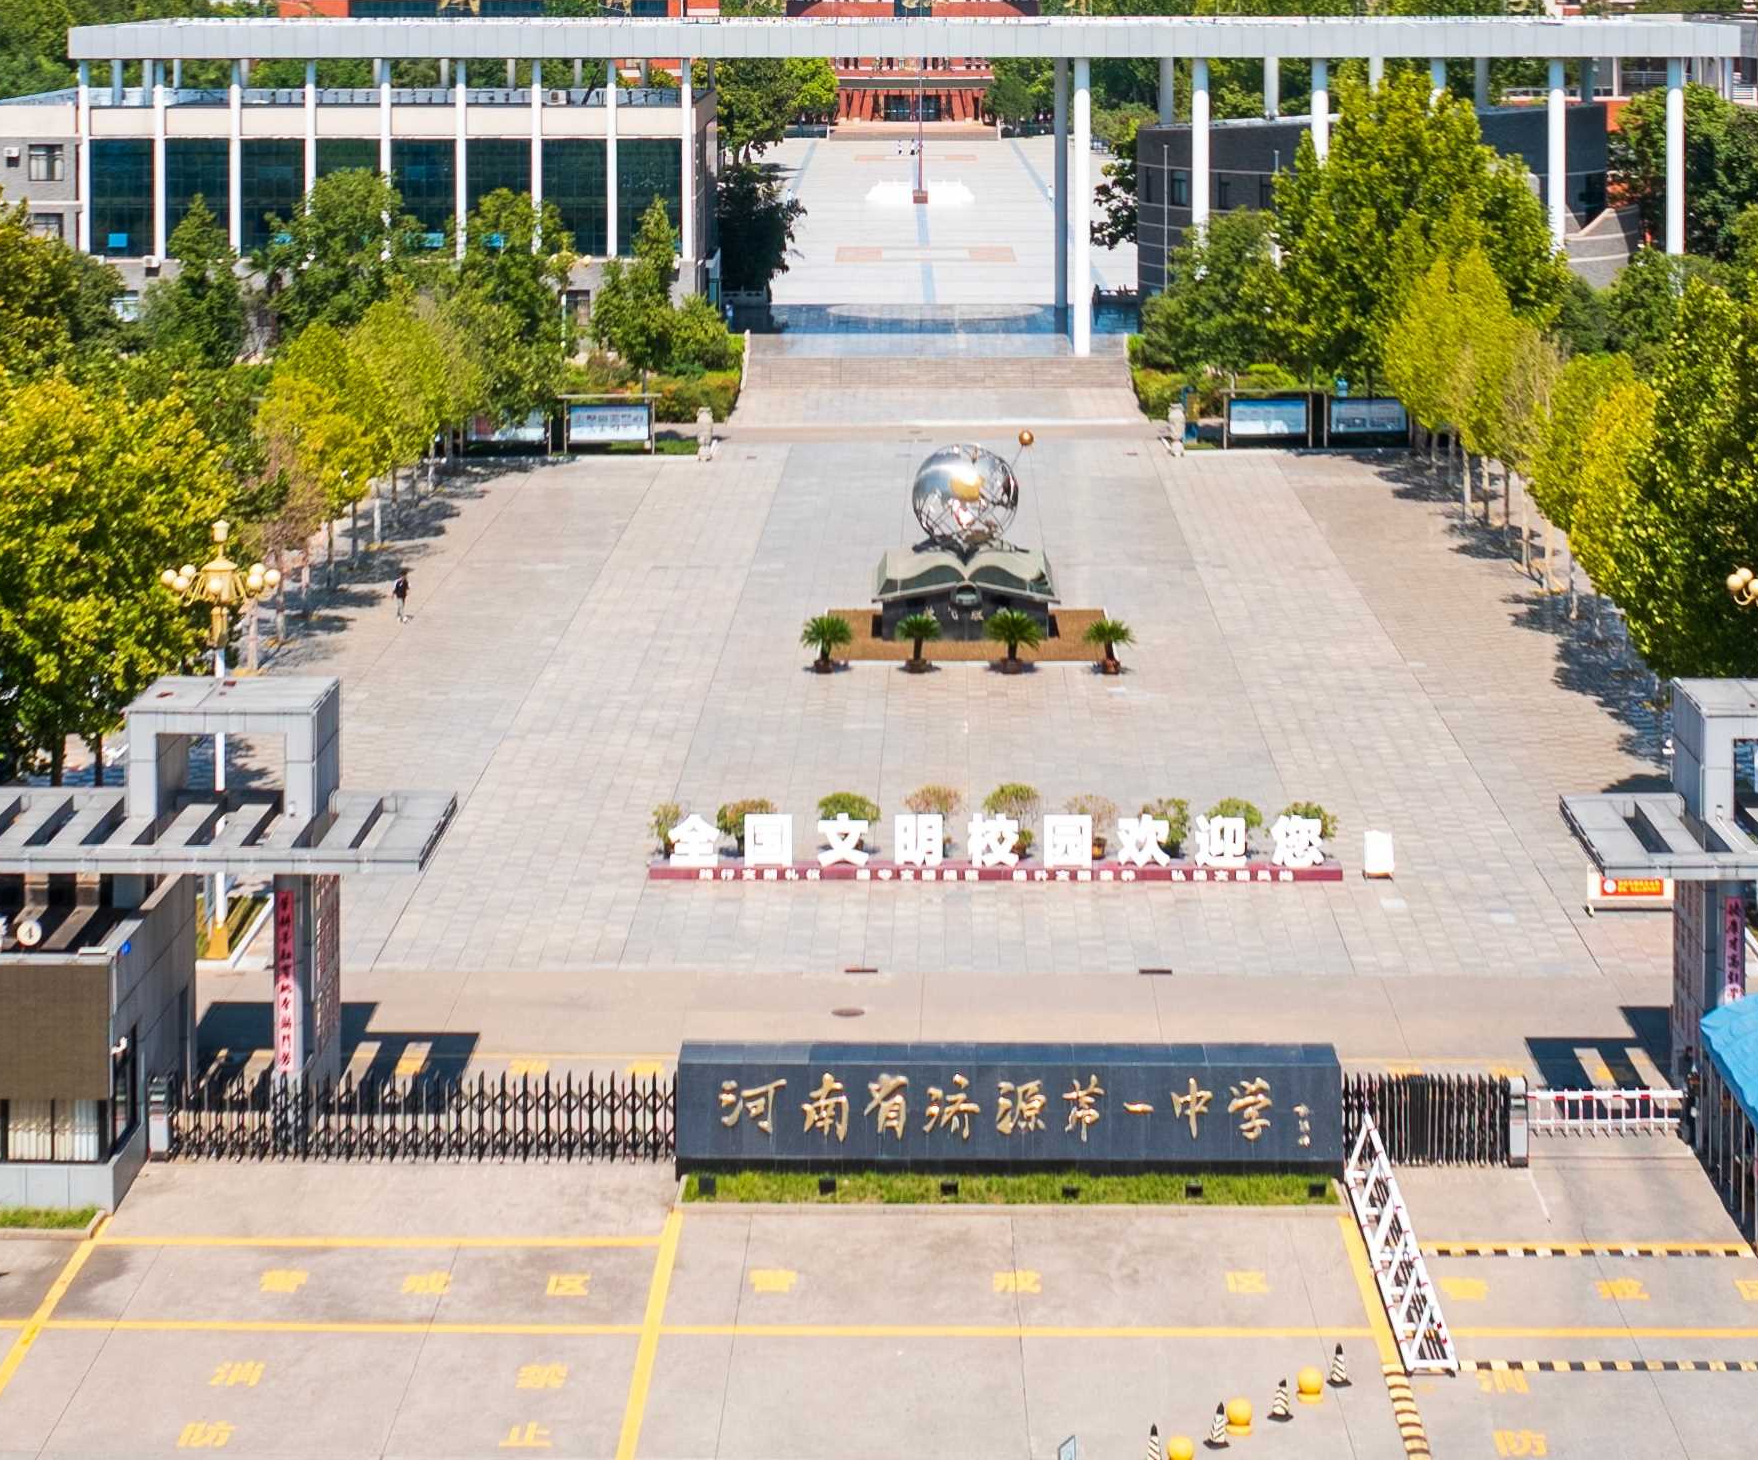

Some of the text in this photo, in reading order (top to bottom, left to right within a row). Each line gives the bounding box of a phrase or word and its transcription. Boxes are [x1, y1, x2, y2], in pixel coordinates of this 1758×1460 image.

[669, 812, 1325, 867] 全国文明校园欢迎您
[718, 1072, 1273, 1142] 河南省济源第一中学
